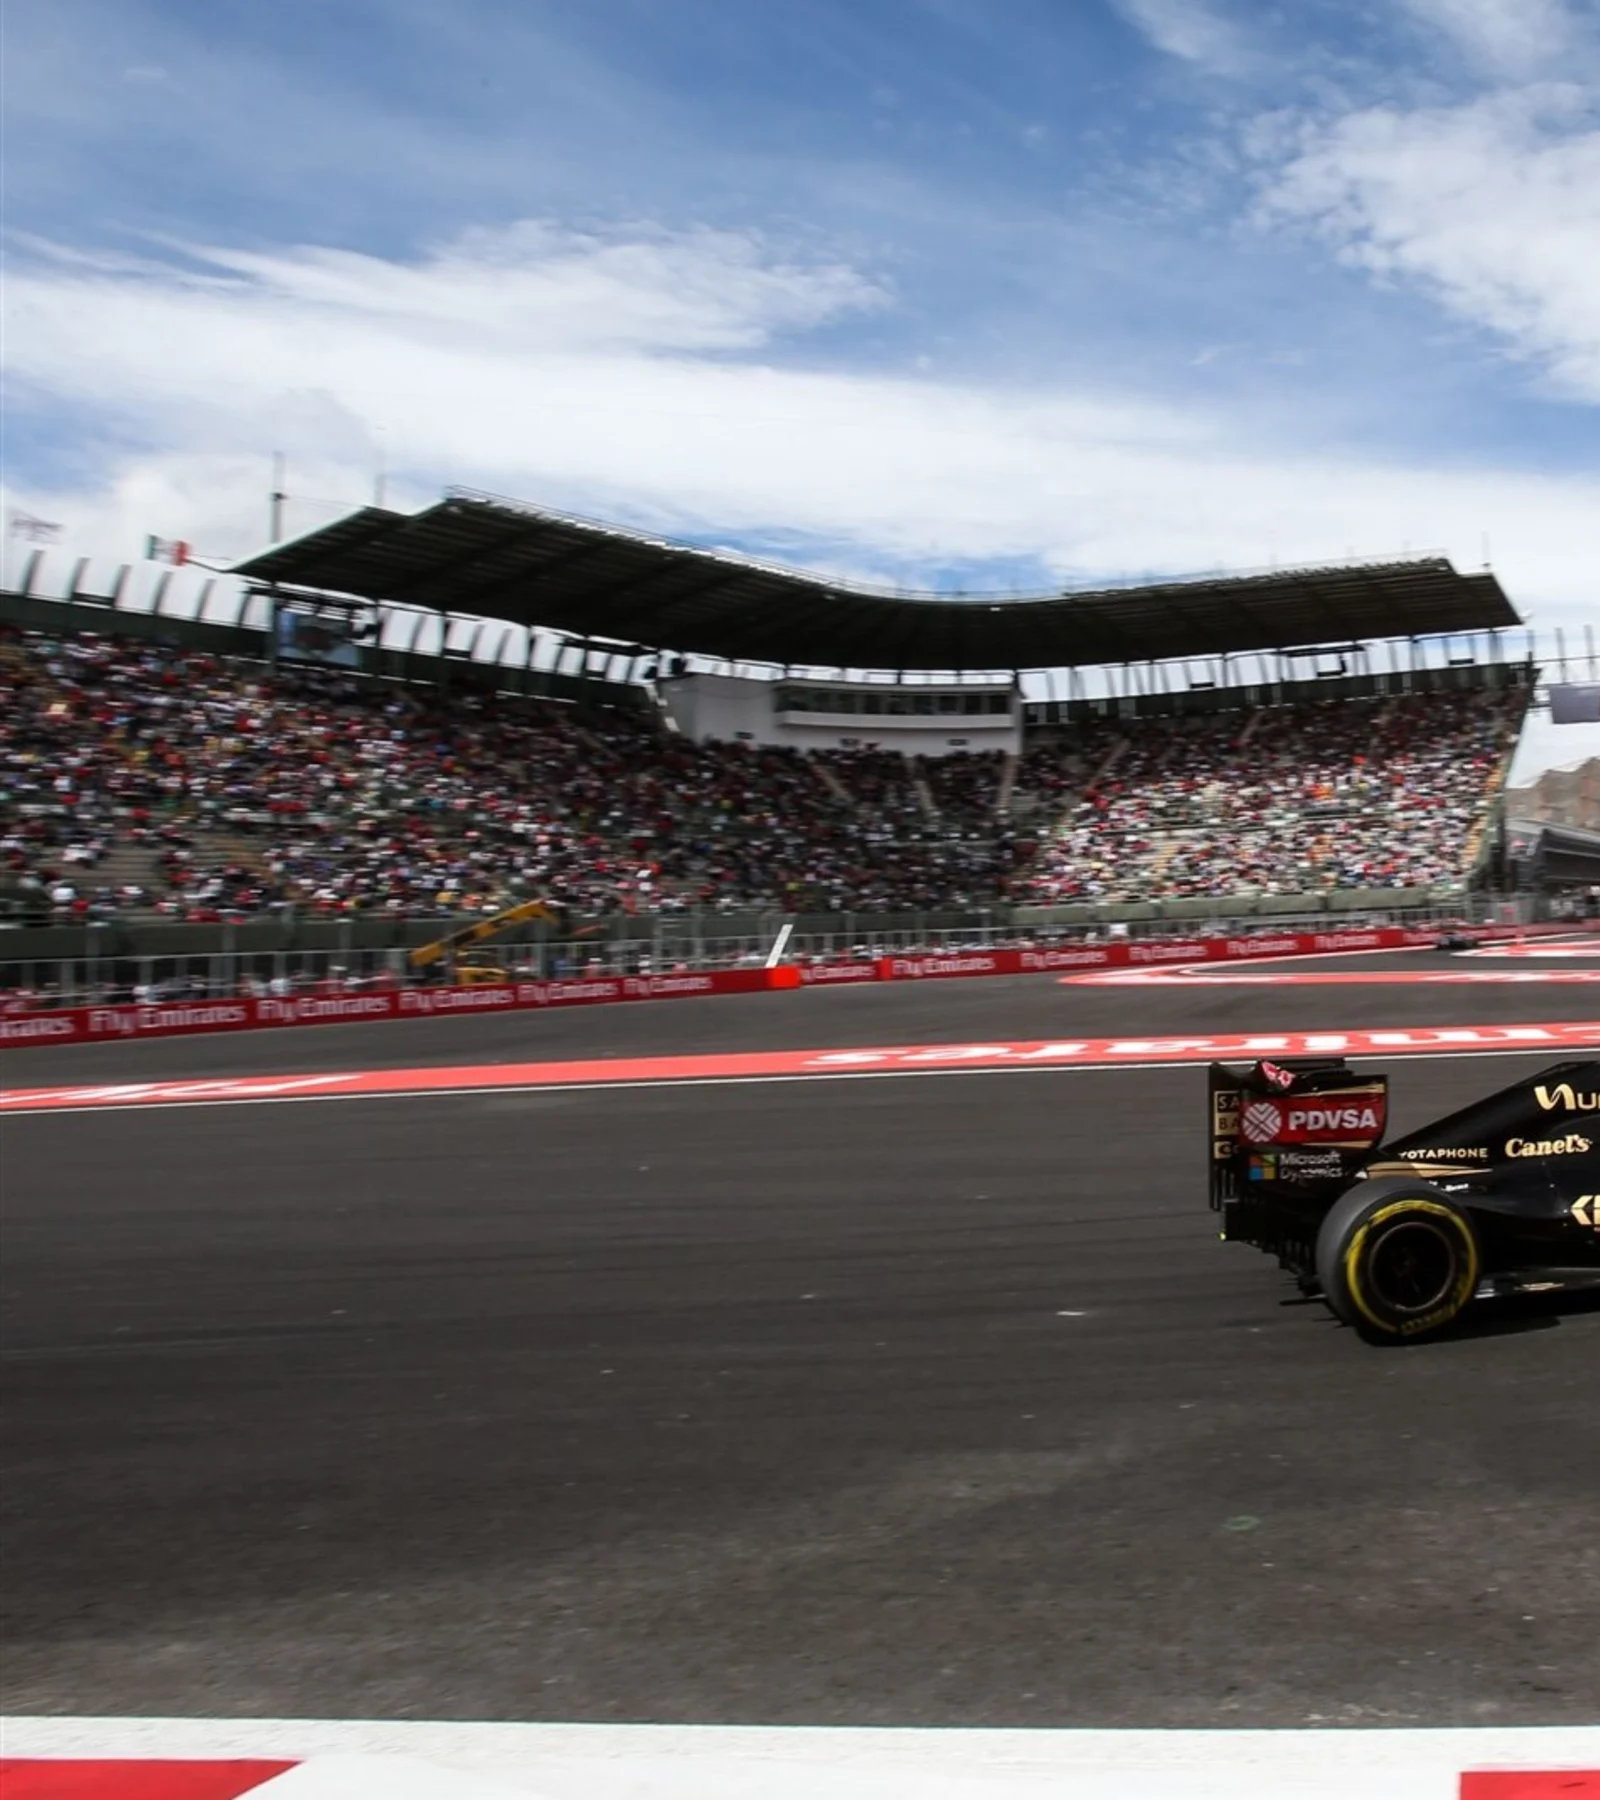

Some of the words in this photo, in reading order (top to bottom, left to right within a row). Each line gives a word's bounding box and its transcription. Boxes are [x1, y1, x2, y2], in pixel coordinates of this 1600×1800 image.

[924, 955, 995, 973] Emirates
[400, 991, 434, 1011] Fly
[433, 988, 513, 1008] Emirates
[548, 981, 617, 1000] Emirates
[90, 1010, 136, 1034] Fly
[138, 1004, 246, 1028] Emirates
[258, 1000, 297, 1022] Fly
[298, 995, 389, 1016] Emirates
[1289, 1109, 1377, 1131] PDVSA
[1505, 1134, 1593, 1158] Canel's
[1280, 1151, 1341, 1166] Microsoft
